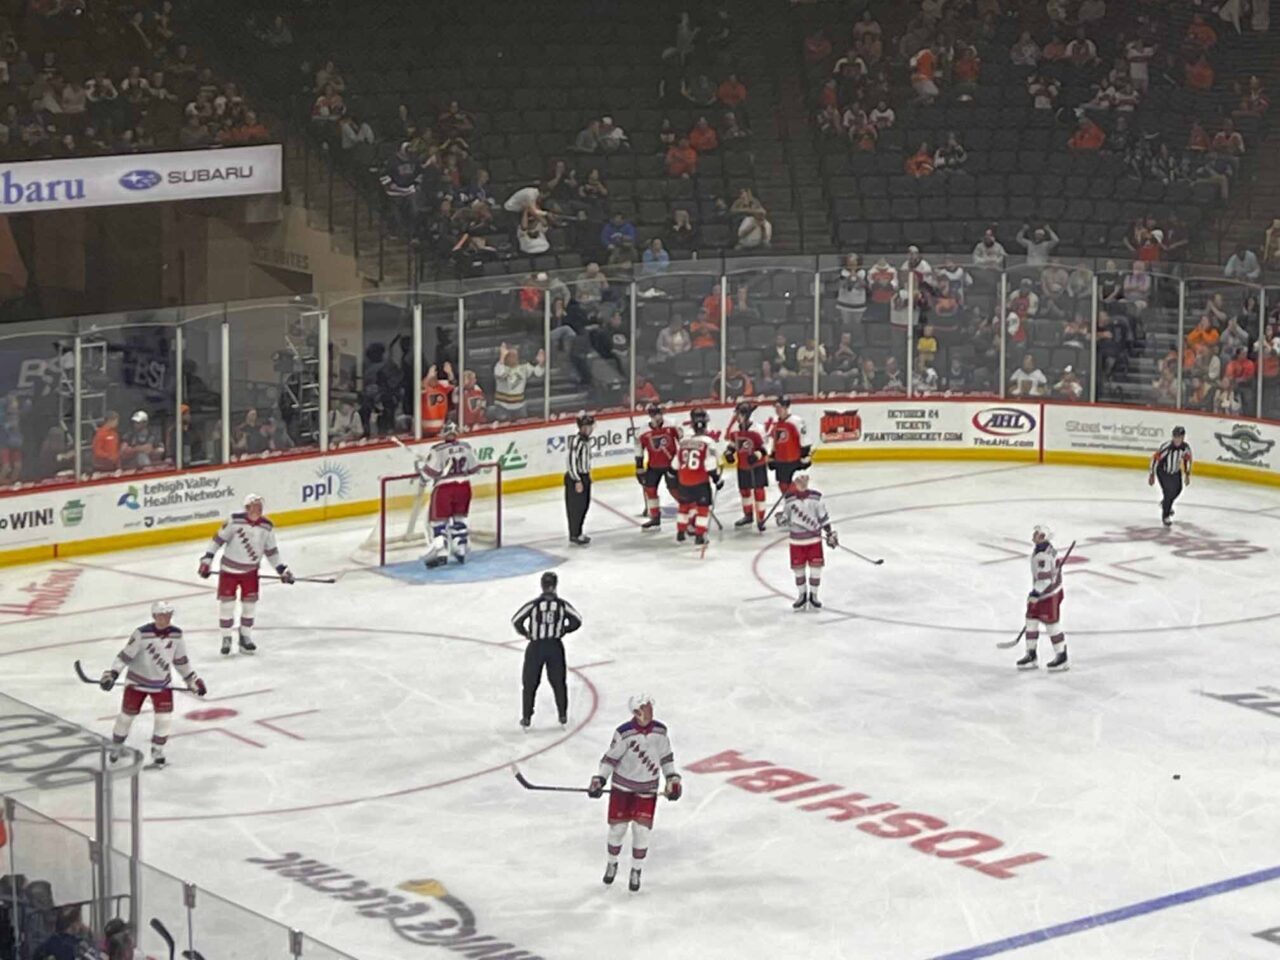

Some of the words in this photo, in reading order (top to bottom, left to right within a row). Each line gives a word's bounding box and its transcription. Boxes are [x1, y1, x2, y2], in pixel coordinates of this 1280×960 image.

[167, 165, 254, 185] SUBARU
[983, 413, 1025, 430] AHL
[143, 479, 185, 498] Lehigh
[186, 476, 221, 494] Valley
[143, 491, 183, 508] Health
[185, 485, 235, 505] Network
[302, 476, 333, 503] ppl
[10, 508, 54, 530] WIN!
[683, 749, 1052, 881] TOSHIBA
